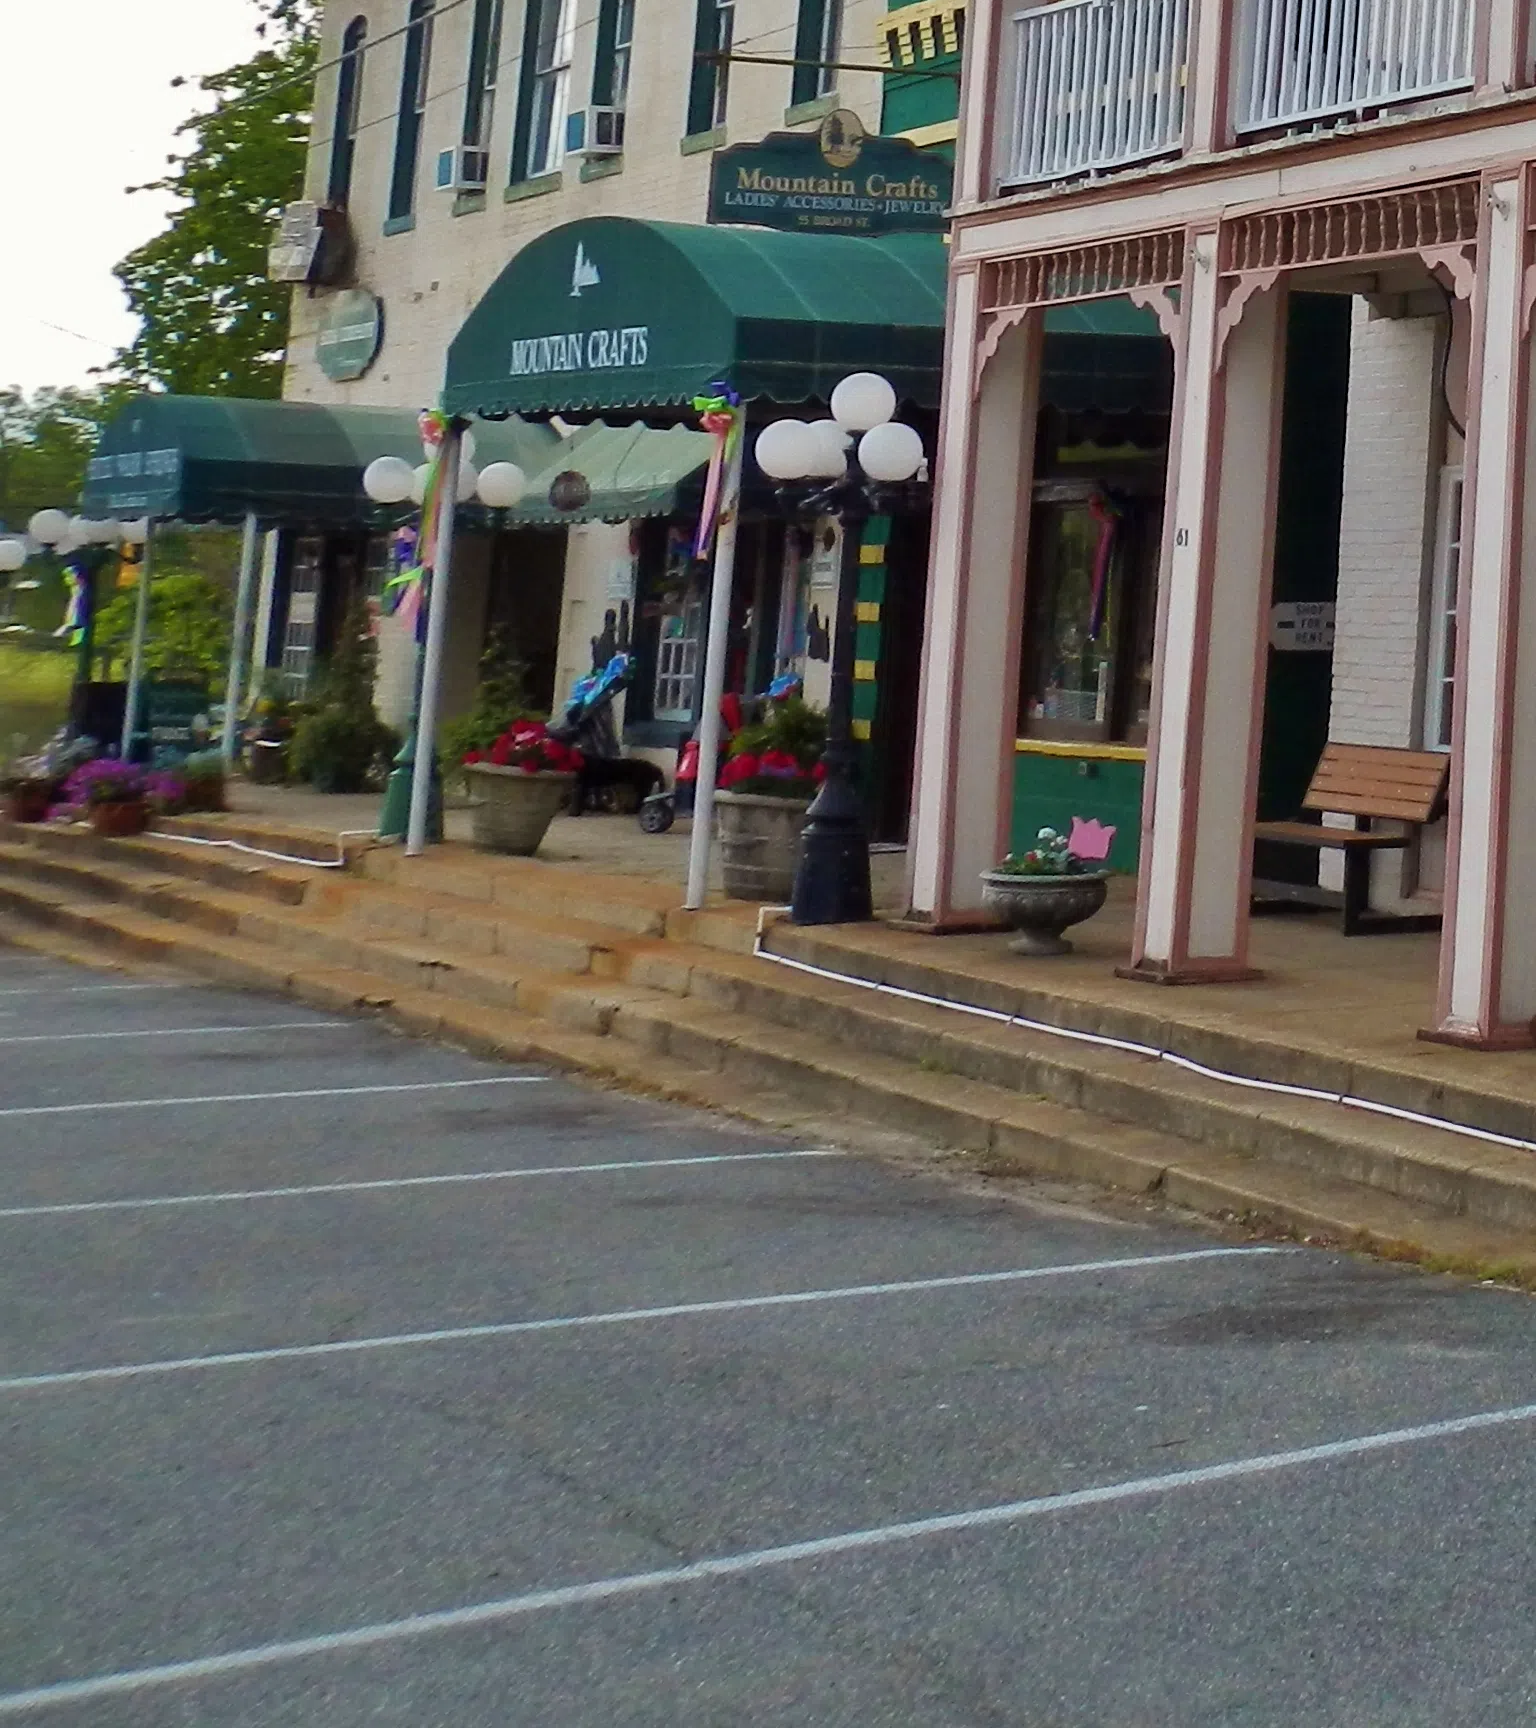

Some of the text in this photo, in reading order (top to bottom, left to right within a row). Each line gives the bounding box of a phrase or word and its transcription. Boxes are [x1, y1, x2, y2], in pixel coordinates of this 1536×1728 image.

[737, 166, 939, 200] Mountain Crafts
[783, 195, 876, 212] ACCESSORIES
[509, 326, 648, 376] MOUNTAIN CRAFTS
[1176, 527, 1189, 547] 61
